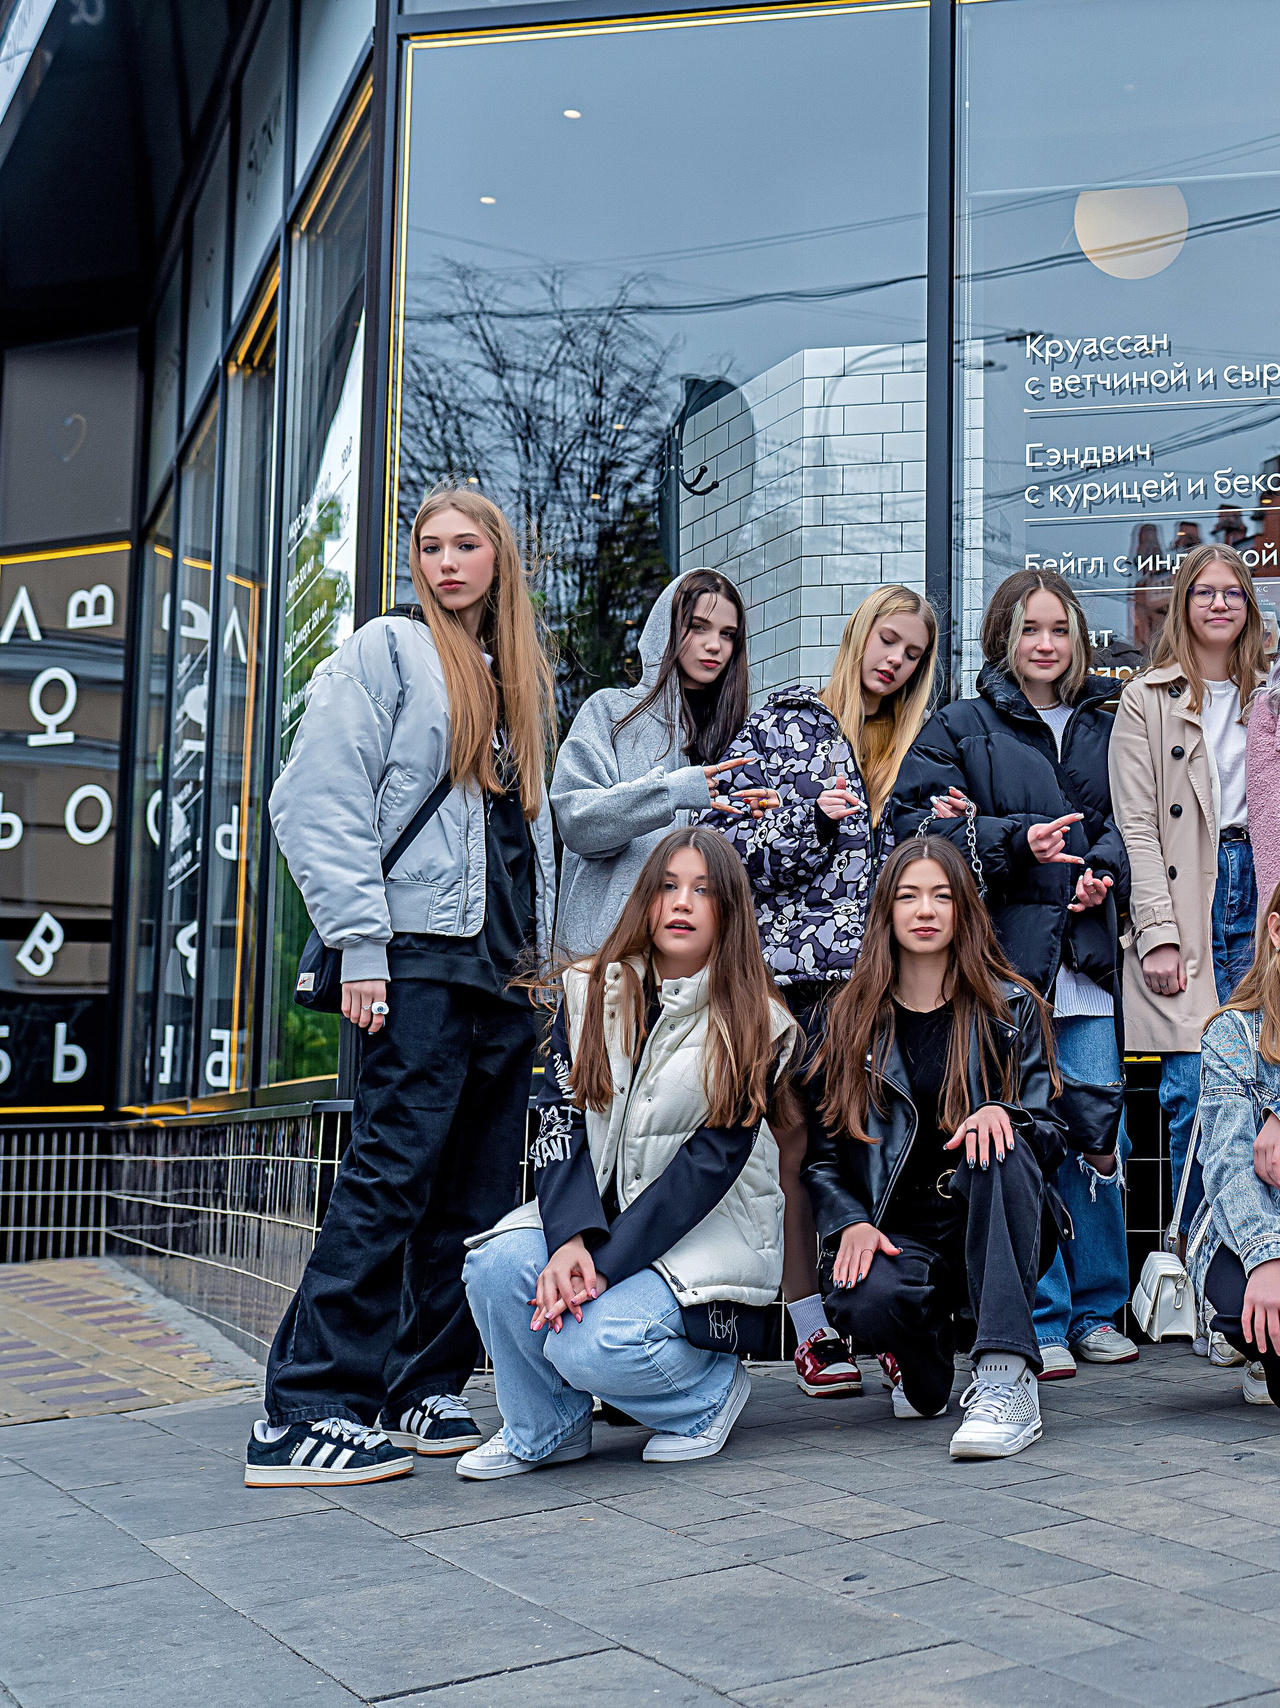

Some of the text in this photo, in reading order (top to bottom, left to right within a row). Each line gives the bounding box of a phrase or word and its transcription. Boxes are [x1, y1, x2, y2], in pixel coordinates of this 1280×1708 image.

[1025, 333, 1168, 365] Круассан
[1024, 376, 1040, 395] с
[1050, 361, 1187, 393] ветчиной
[1197, 367, 1214, 385] и
[1024, 485, 1041, 504] с
[1049, 471, 1178, 509] курицей
[1187, 478, 1205, 496] и
[1025, 551, 1104, 575] Бейгл
[1112, 555, 1129, 574] с
